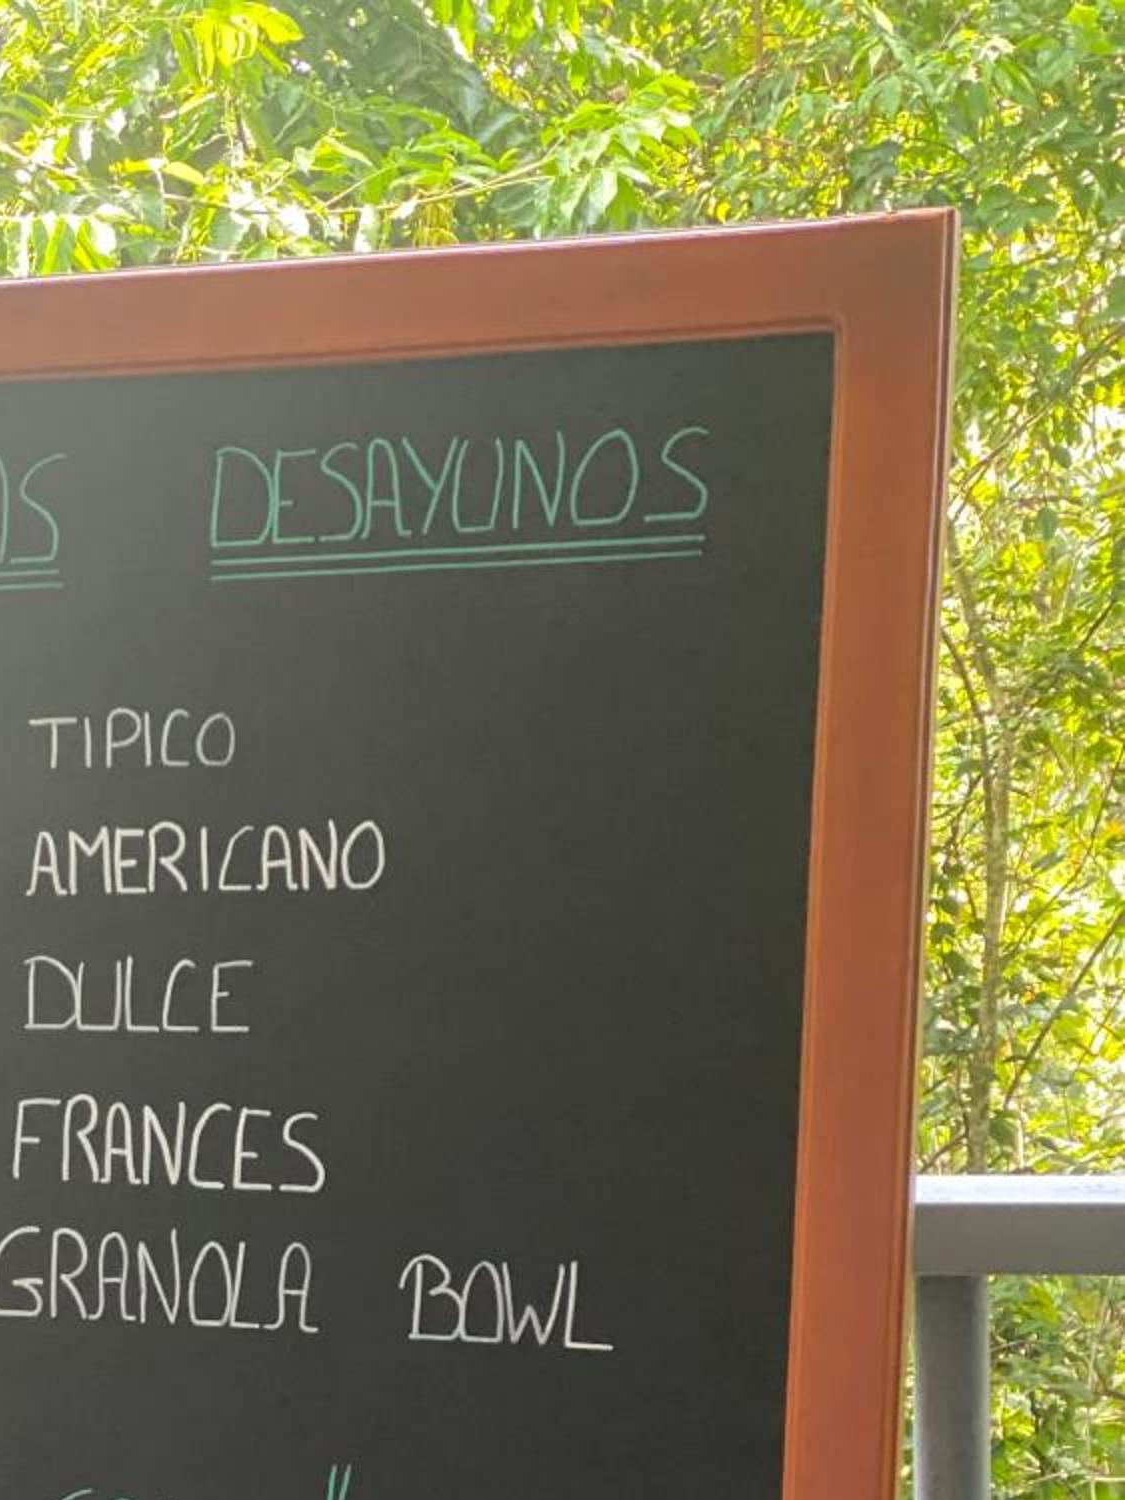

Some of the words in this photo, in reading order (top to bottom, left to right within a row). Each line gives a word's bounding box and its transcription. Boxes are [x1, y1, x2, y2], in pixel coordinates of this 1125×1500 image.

[209, 426, 710, 549] DESAYUNOS
[27, 706, 236, 770] TIPICO
[25, 818, 386, 897] AMERICANO
[23, 954, 255, 1034] DULCE
[11, 1092, 326, 1194] FRANCES
[397, 1253, 615, 1352] BOWL
